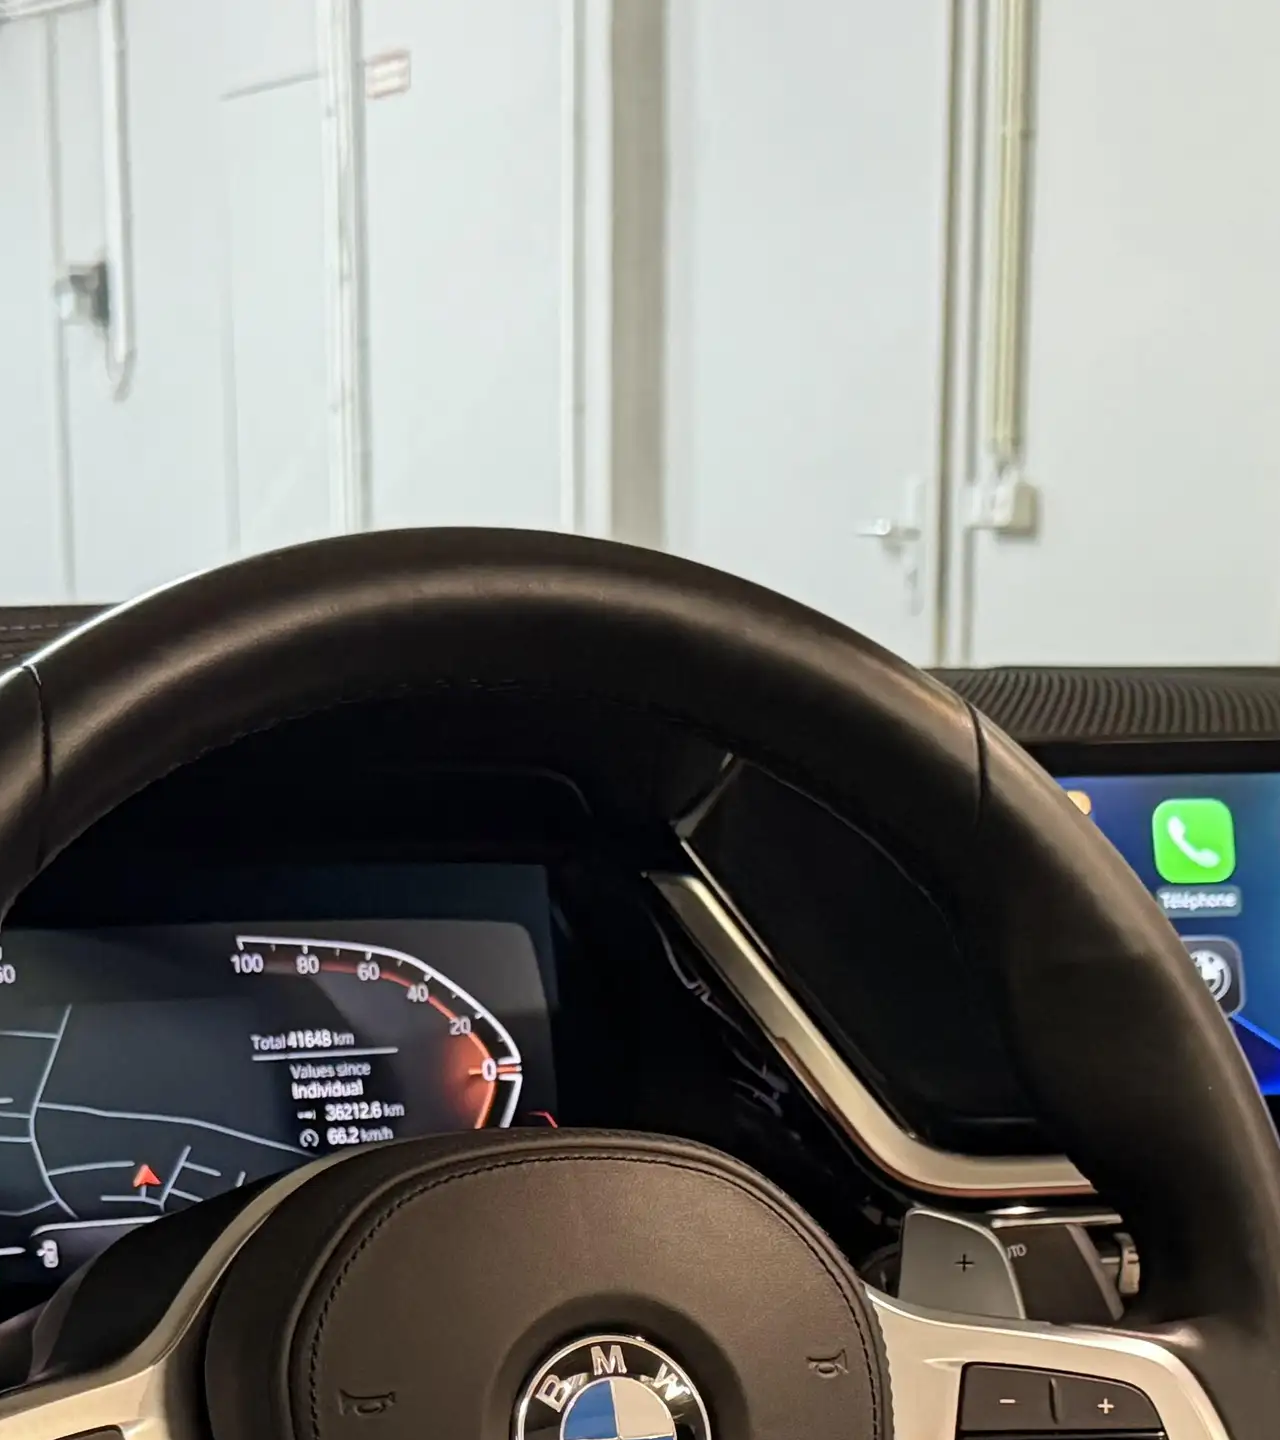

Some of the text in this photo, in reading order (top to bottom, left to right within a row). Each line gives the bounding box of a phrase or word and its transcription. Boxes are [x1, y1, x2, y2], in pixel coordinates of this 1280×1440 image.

[230, 953, 264, 974] 100
[296, 955, 320, 974] 80
[357, 961, 380, 981] 60
[407, 983, 429, 1003] 40
[449, 1015, 471, 1036] 20
[250, 1029, 355, 1051] Total 41648 km
[290, 1060, 371, 1080] Values since
[481, 1057, 497, 1081] 0
[292, 1078, 364, 1100] Individual
[382, 1099, 405, 1117] km
[326, 1125, 394, 1145] 66.2 km/h
[535, 1344, 692, 1413] BMW
